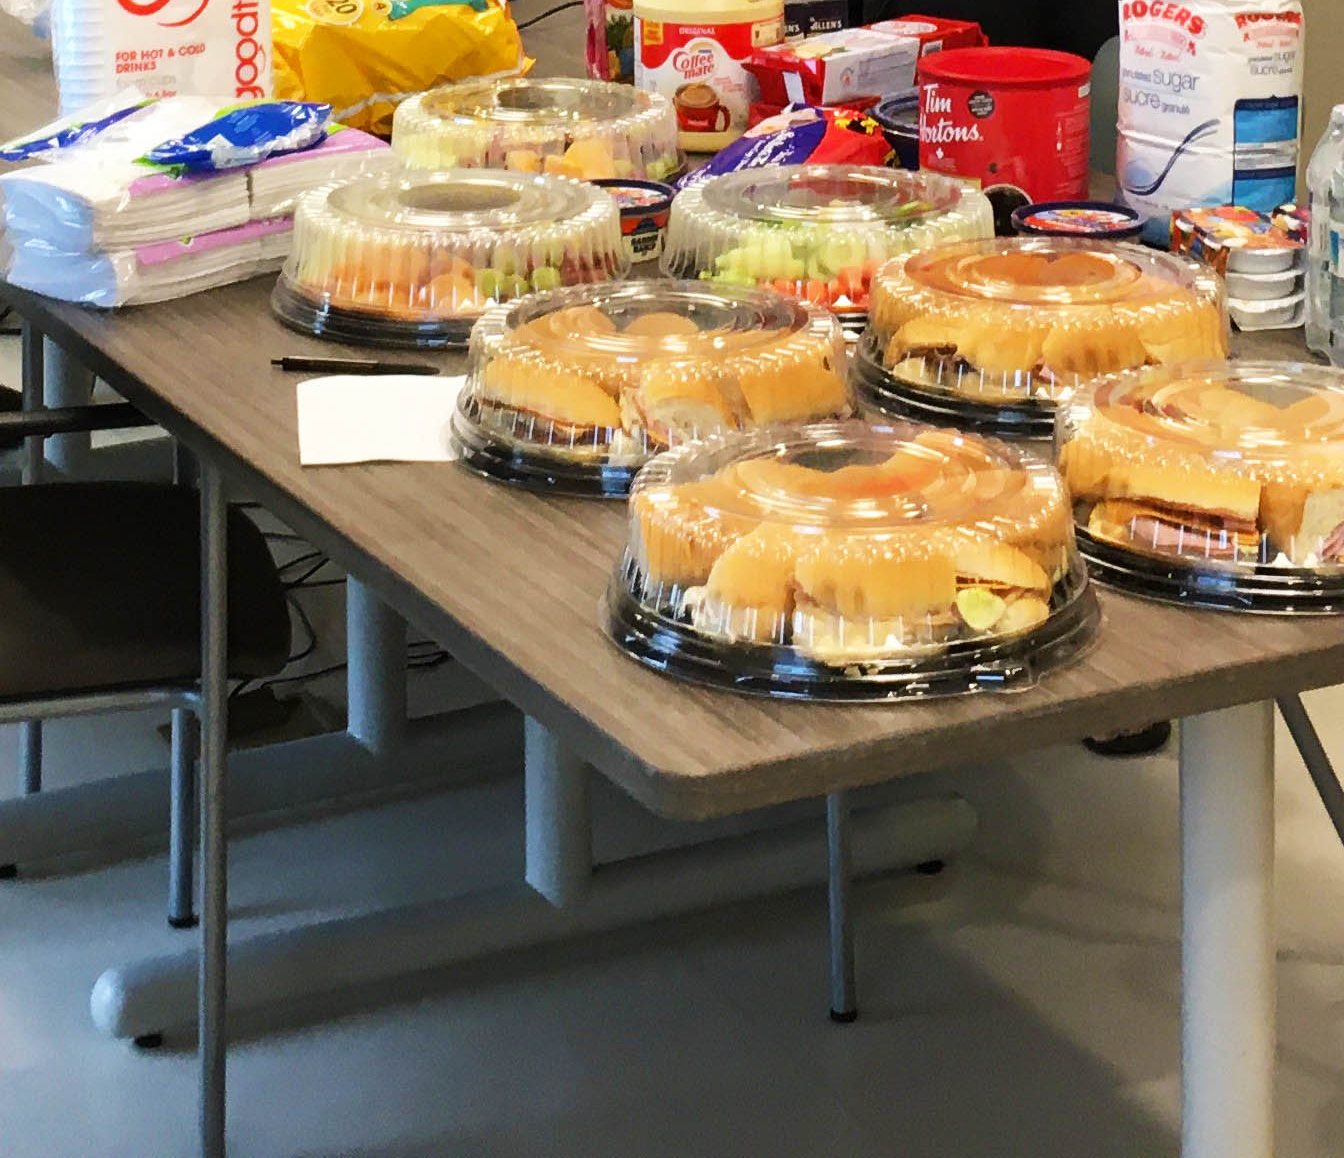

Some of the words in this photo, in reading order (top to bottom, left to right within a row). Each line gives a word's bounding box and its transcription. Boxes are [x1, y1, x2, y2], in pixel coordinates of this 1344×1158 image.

[1122, 0, 1205, 35] ROGERS
[115, 50, 137, 62] FOR
[141, 48, 164, 60] HOT
[178, 42, 206, 56] COLD
[672, 50, 714, 73] Coffee
[115, 61, 157, 74] DRINKS
[684, 64, 715, 80] mate
[1153, 69, 1201, 93] sugar
[923, 83, 952, 114] Tim
[1123, 88, 1161, 109] sucre
